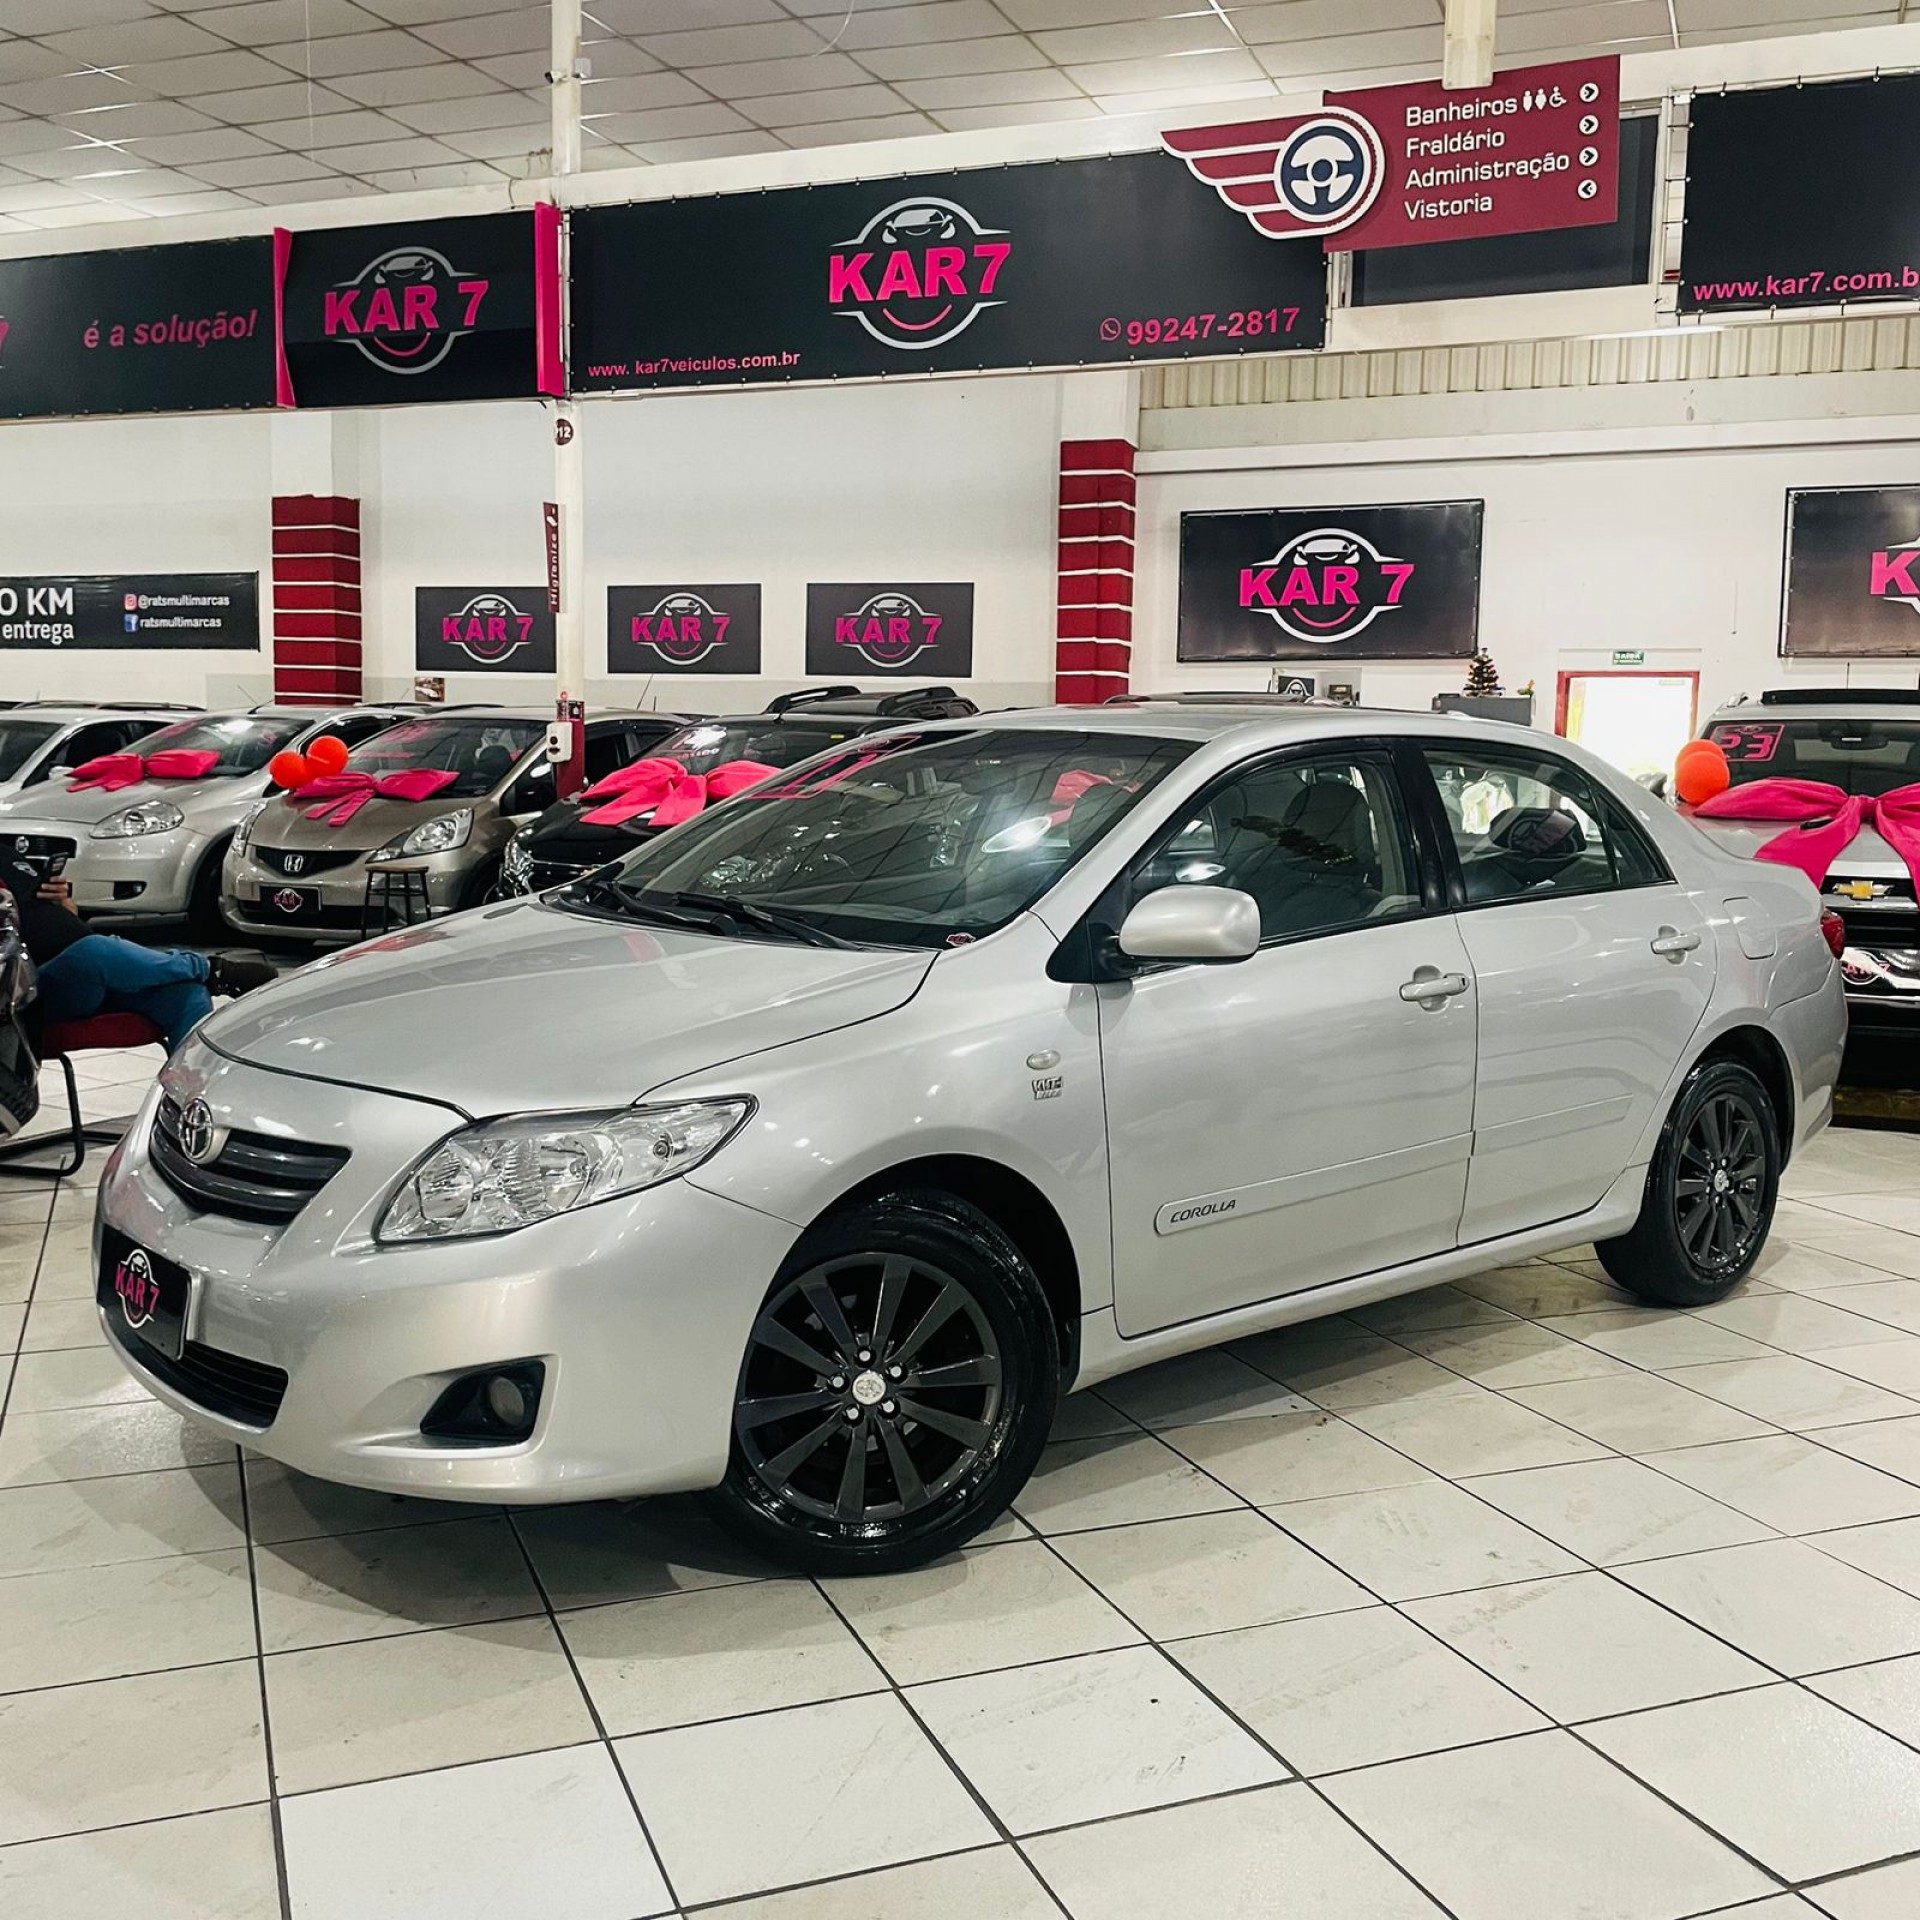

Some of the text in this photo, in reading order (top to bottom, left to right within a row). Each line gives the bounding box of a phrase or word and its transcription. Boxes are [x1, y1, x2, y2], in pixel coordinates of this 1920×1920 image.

[1406, 97, 1518, 127] Banheiros
[1406, 128, 1505, 158] Fraldário
[1405, 152, 1570, 189] Administração
[1404, 192, 1493, 220] Vistoria
[325, 280, 489, 336] KAR 7
[83, 309, 258, 348] é a solução!
[1126, 307, 1300, 346] 99247-2817
[635, 351, 800, 375] kar7veiculos.com.br
[1239, 563, 1416, 607] KAR 7
[27, 587, 73, 616] KM
[138, 594, 230, 609] @ratsmultimarcas
[2, 620, 74, 645] entrega
[140, 615, 222, 628] ratsmultimarcas
[442, 616, 535, 643] KAR 7
[631, 616, 731, 643] KAR 7
[835, 616, 943, 644] KAR 7
[1170, 1199, 1236, 1224] COROLLA
[115, 1263, 160, 1314] KAR 7
